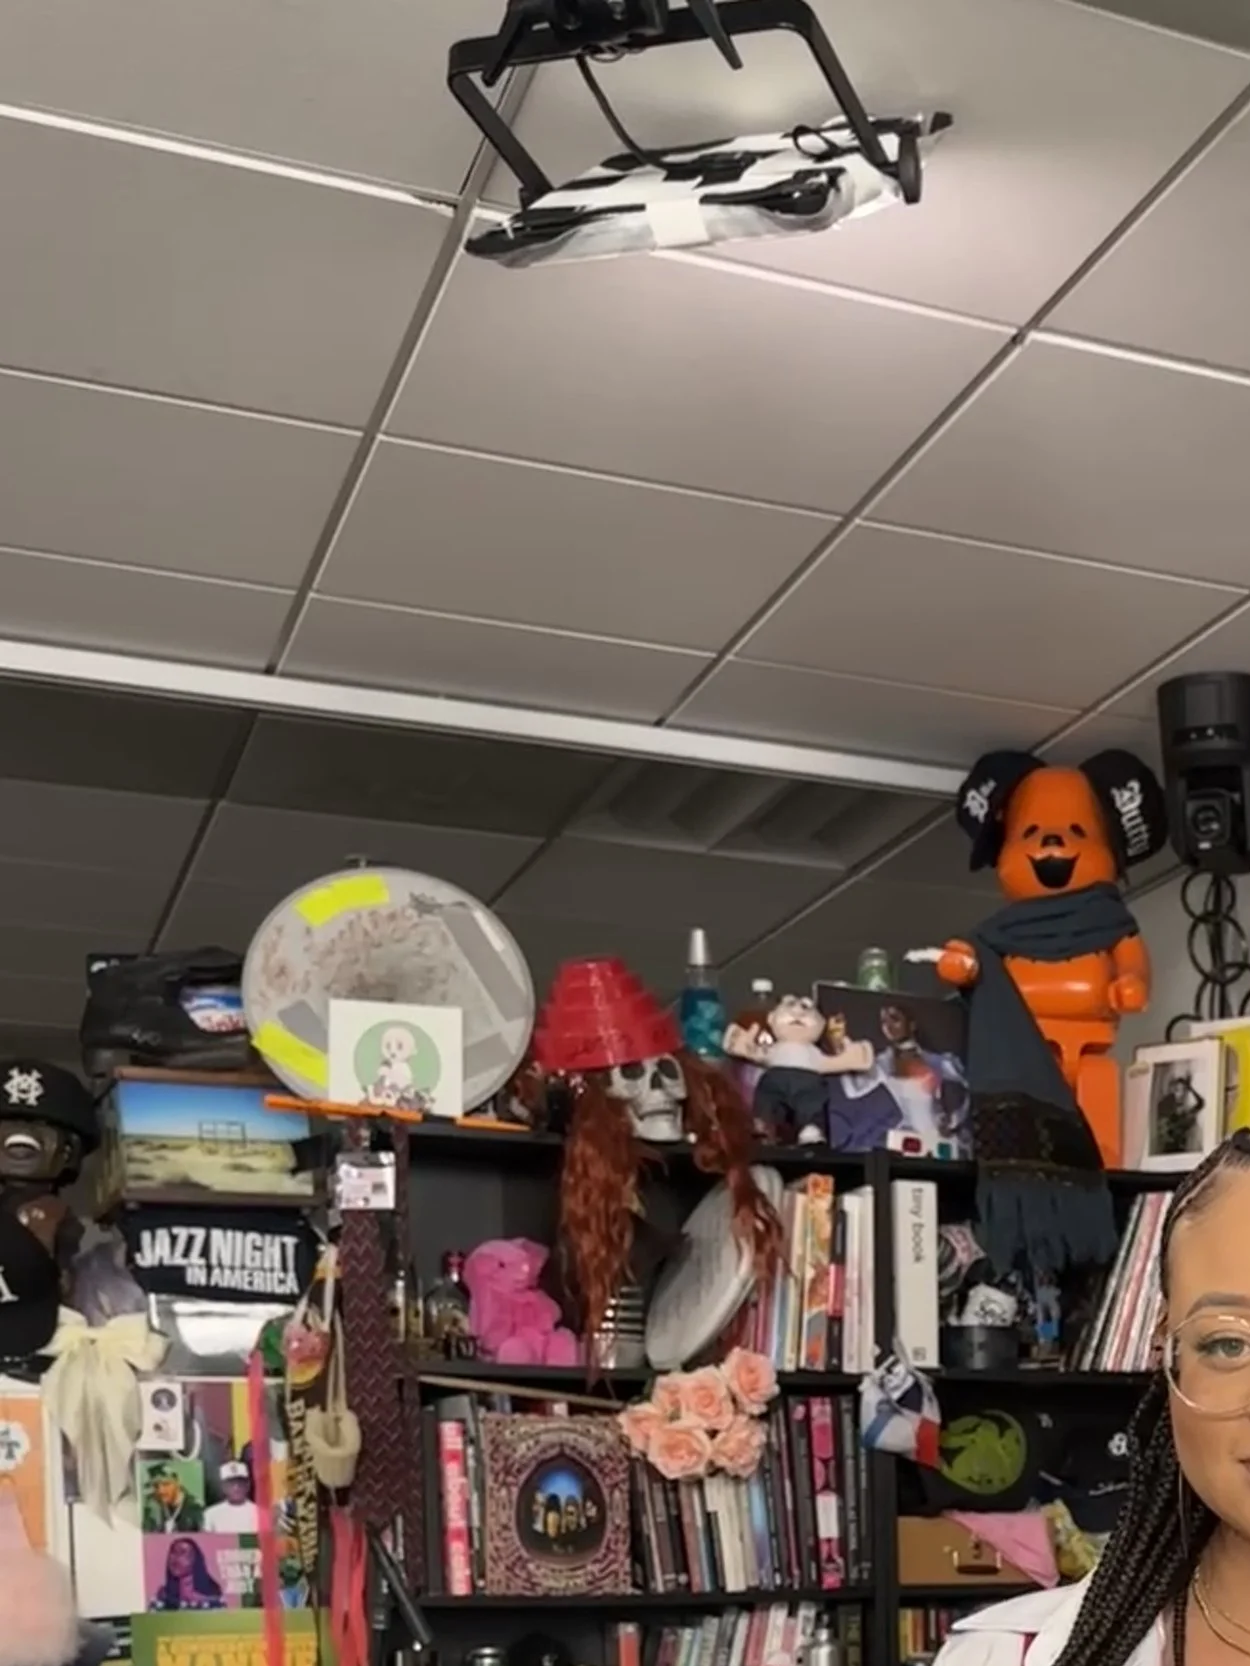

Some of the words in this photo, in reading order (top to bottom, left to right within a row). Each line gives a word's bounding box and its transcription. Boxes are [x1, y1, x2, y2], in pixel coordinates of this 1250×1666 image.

[910, 1186, 927, 1219] tiny
[134, 1226, 207, 1269] JAZZ
[209, 1227, 299, 1272] NIGHT
[911, 1224, 926, 1264] book
[185, 1265, 208, 1287] IN
[209, 1267, 300, 1295] AMERICA
